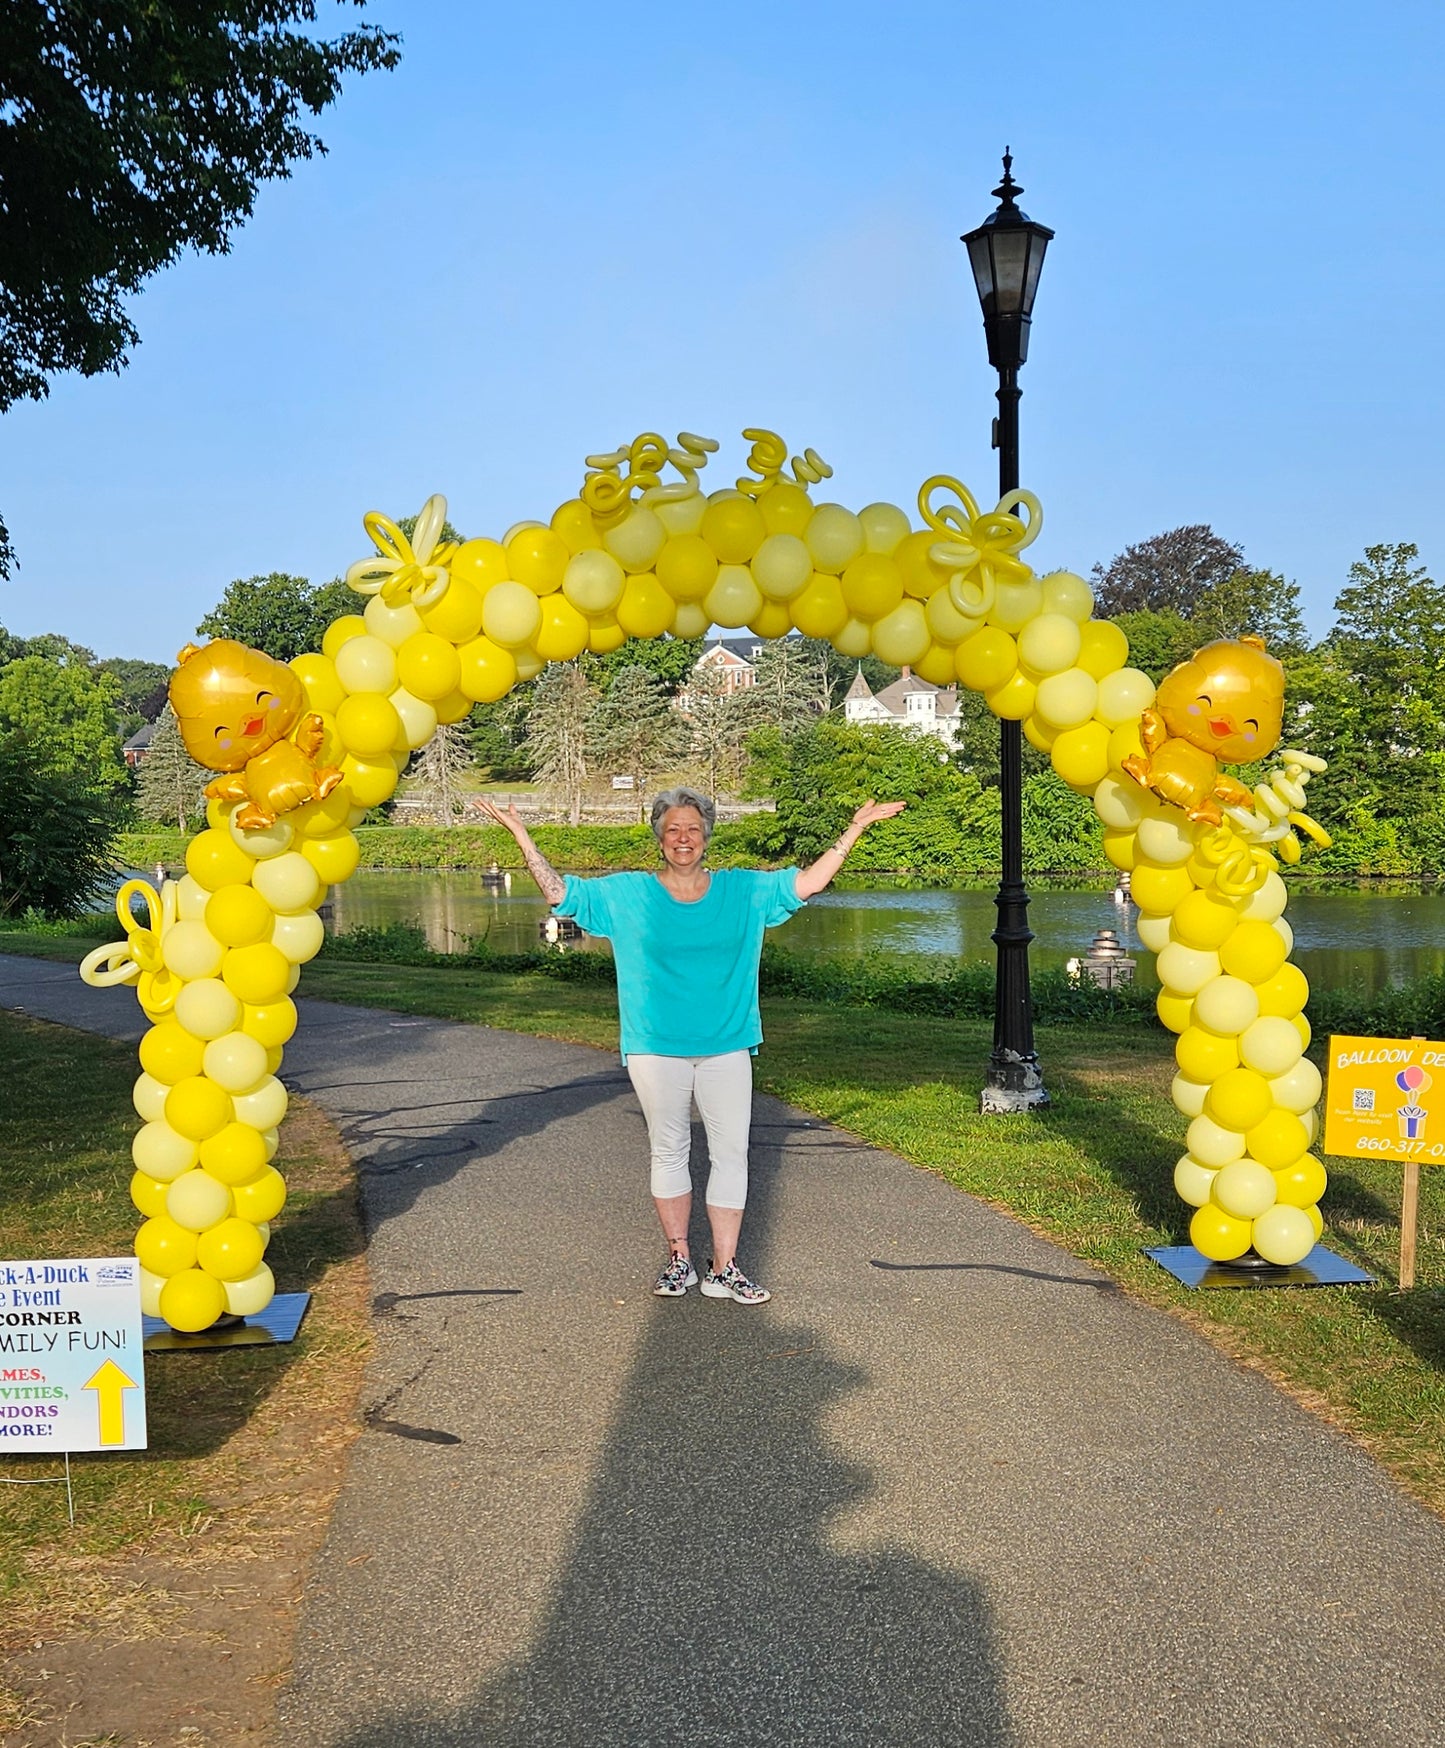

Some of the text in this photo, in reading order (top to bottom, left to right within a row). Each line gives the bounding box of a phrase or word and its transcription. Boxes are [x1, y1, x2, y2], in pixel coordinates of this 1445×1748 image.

[1338, 1049, 1413, 1069] BALLOON
[1356, 1136, 1445, 1157] 860-317-0
[12, 1288, 62, 1307] Event
[68, 1329, 127, 1351] FUN!
[0, 1368, 46, 1383] MES,
